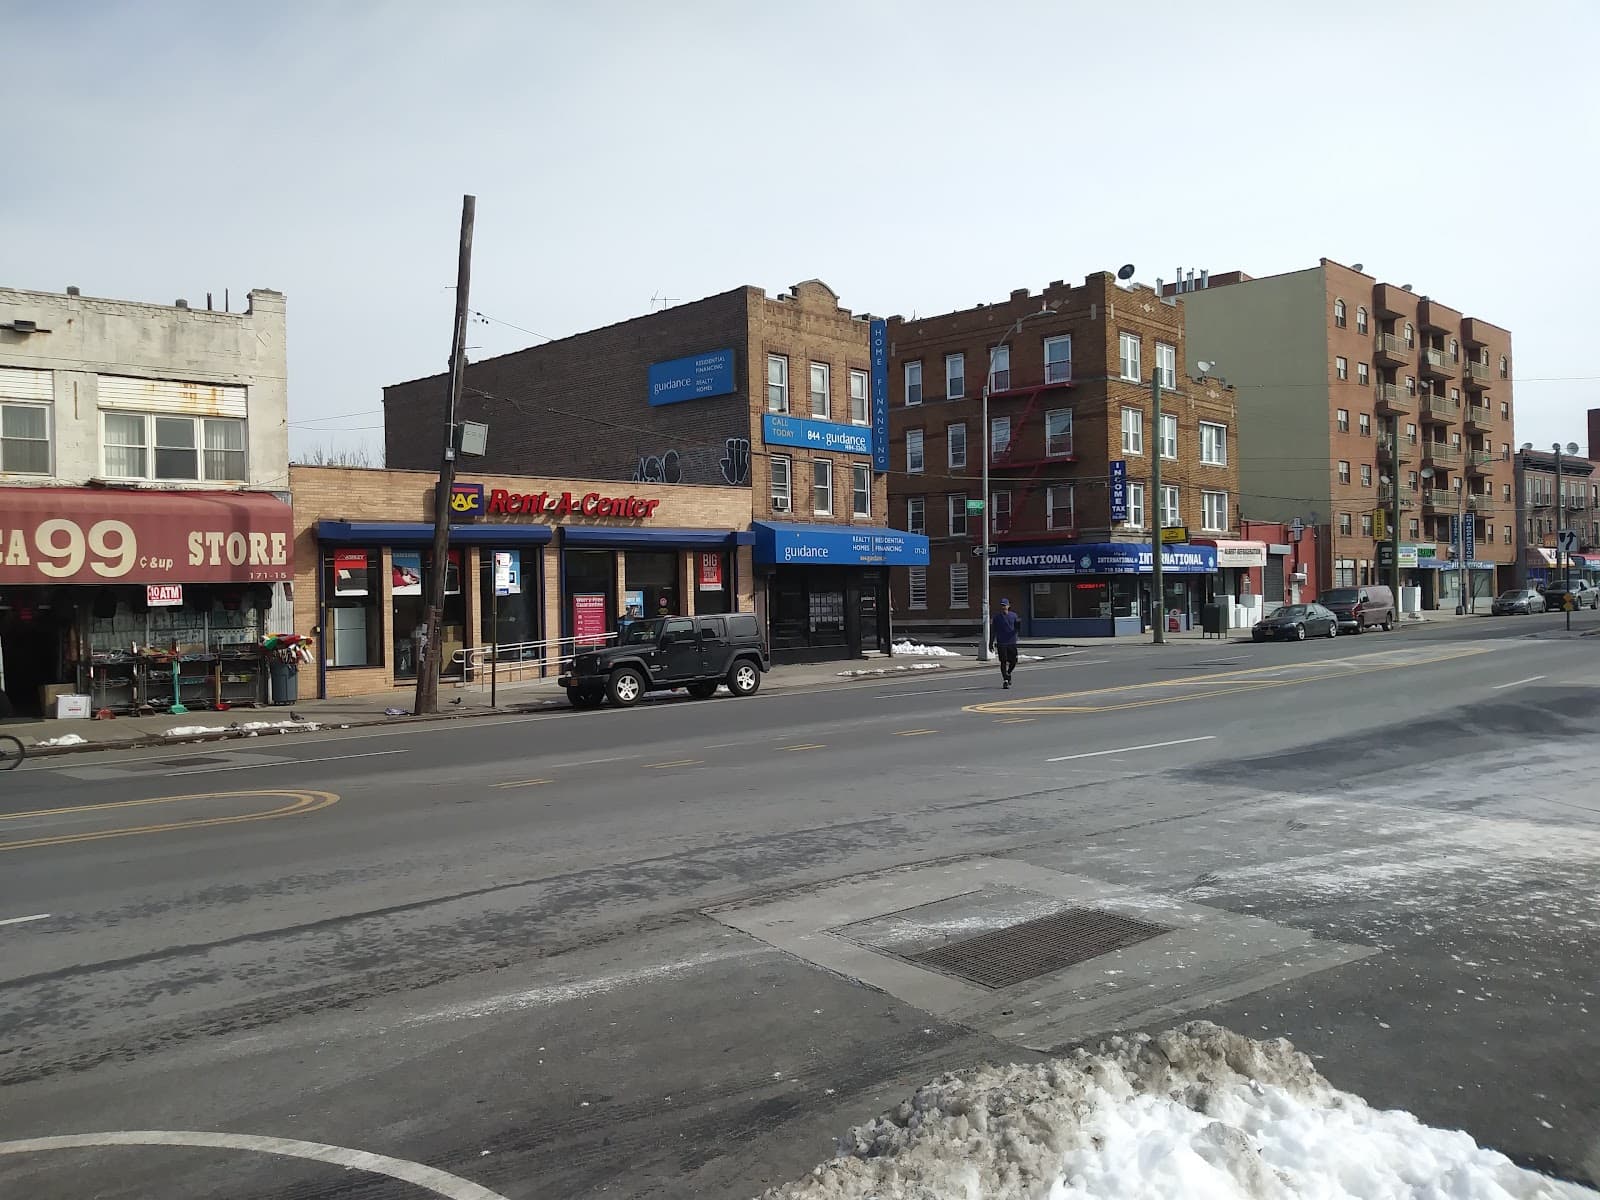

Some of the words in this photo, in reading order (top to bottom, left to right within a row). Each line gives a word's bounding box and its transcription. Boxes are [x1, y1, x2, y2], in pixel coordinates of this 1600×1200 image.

[695, 356, 725, 366] RESIDENTIAL
[695, 364, 723, 374] FINANCING
[654, 378, 692, 395] guidance
[696, 378, 713, 386] REALTY
[772, 417, 789, 427] CALL
[877, 379, 885, 463] FINANCING
[773, 428, 794, 438] TODAY
[807, 430, 820, 441] 844
[826, 432, 866, 446] guidance
[1113, 462, 1123, 504] INCOME
[852, 535, 871, 543] REALTY
[875, 536, 905, 544] RESIDENTIAL
[34, 518, 138, 578] 99
[188, 531, 287, 566] STORE
[784, 545, 829, 560] guidance
[703, 553, 718, 567] BIG
[1138, 552, 1204, 565] INTRNATIONAL
[160, 586, 180, 600] ATM
